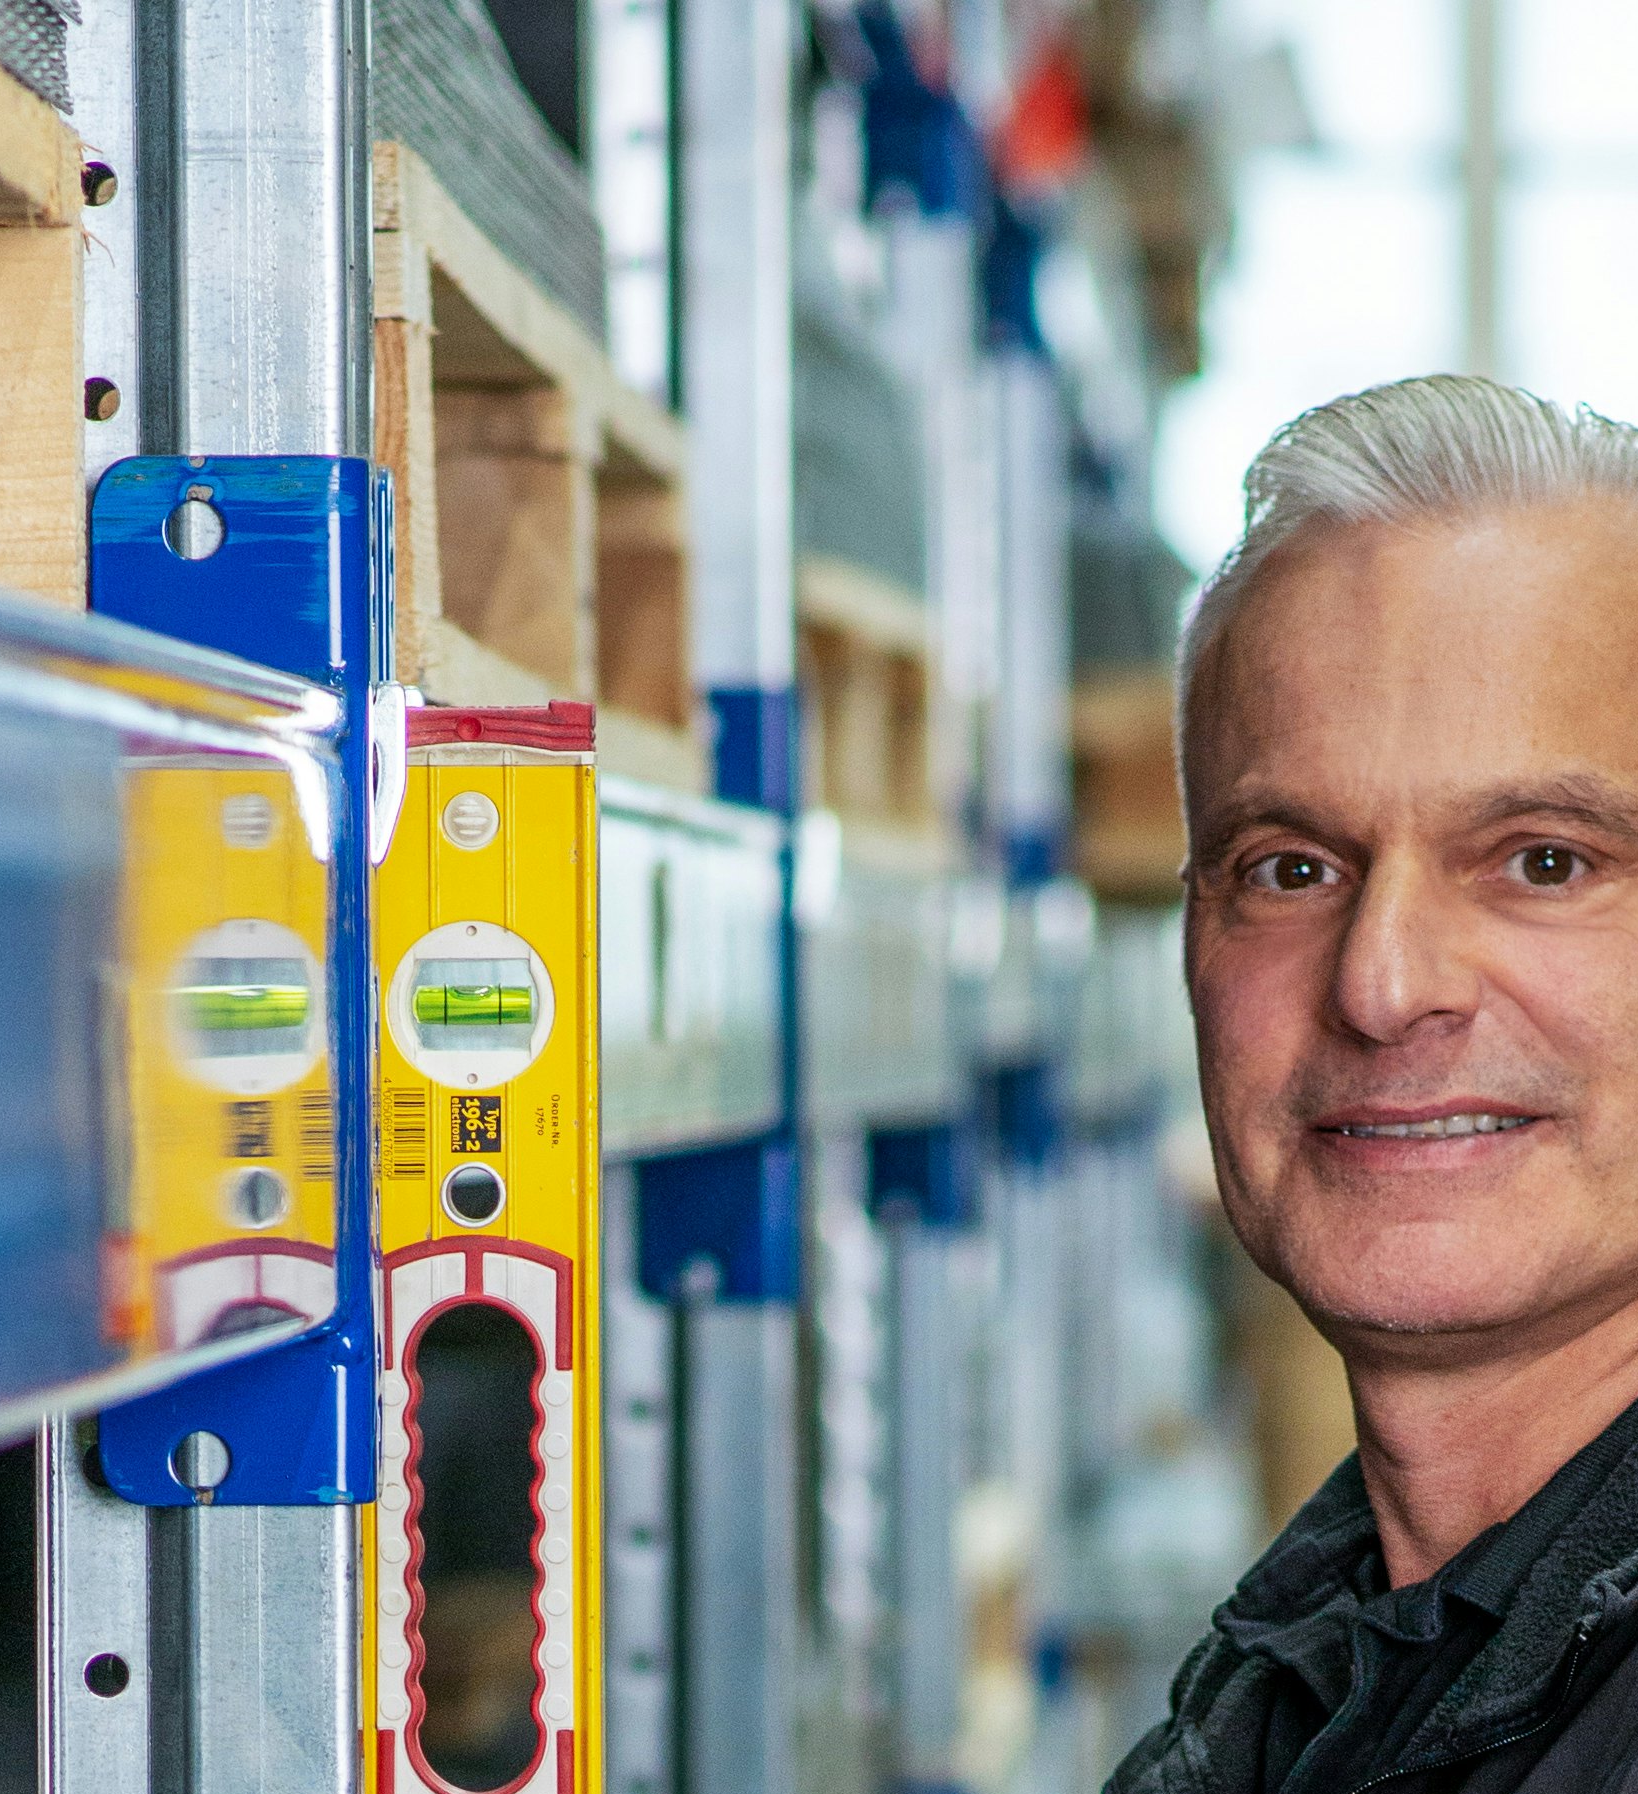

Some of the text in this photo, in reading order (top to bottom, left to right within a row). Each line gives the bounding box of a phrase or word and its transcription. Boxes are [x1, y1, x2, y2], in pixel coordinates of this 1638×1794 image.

[451, 1097, 463, 1151] electronic
[461, 1098, 484, 1151] 196-2
[484, 1108, 500, 1139] Type
[535, 1107, 545, 1136] 17670
